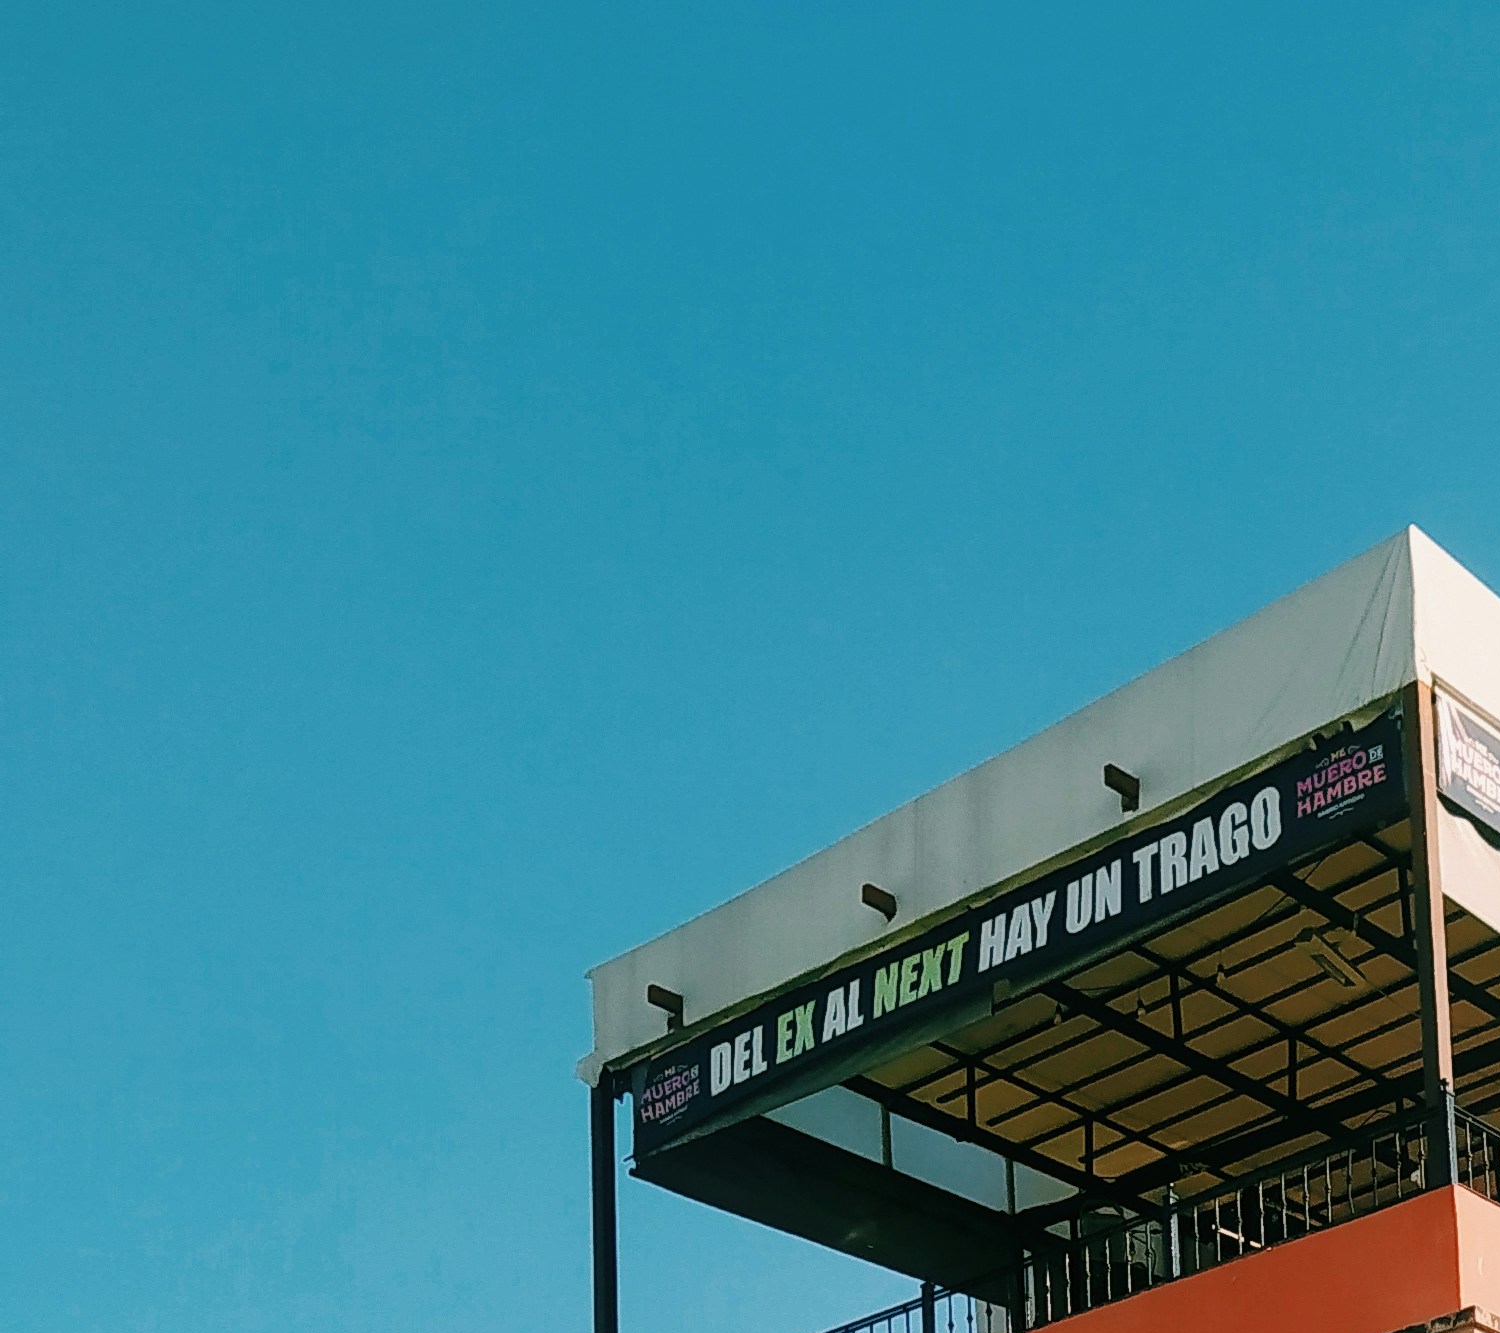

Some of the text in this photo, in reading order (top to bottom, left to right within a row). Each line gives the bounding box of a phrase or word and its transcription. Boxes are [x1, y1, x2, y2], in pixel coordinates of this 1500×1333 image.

[1297, 751, 1367, 798] MUERO
[1297, 763, 1387, 818] HAMBRE
[710, 785, 1282, 1097] DEL EX AL NEXT HAY UN TRAGO
[640, 1070, 690, 1105] MUERO
[640, 1079, 700, 1123] HAMBRE
